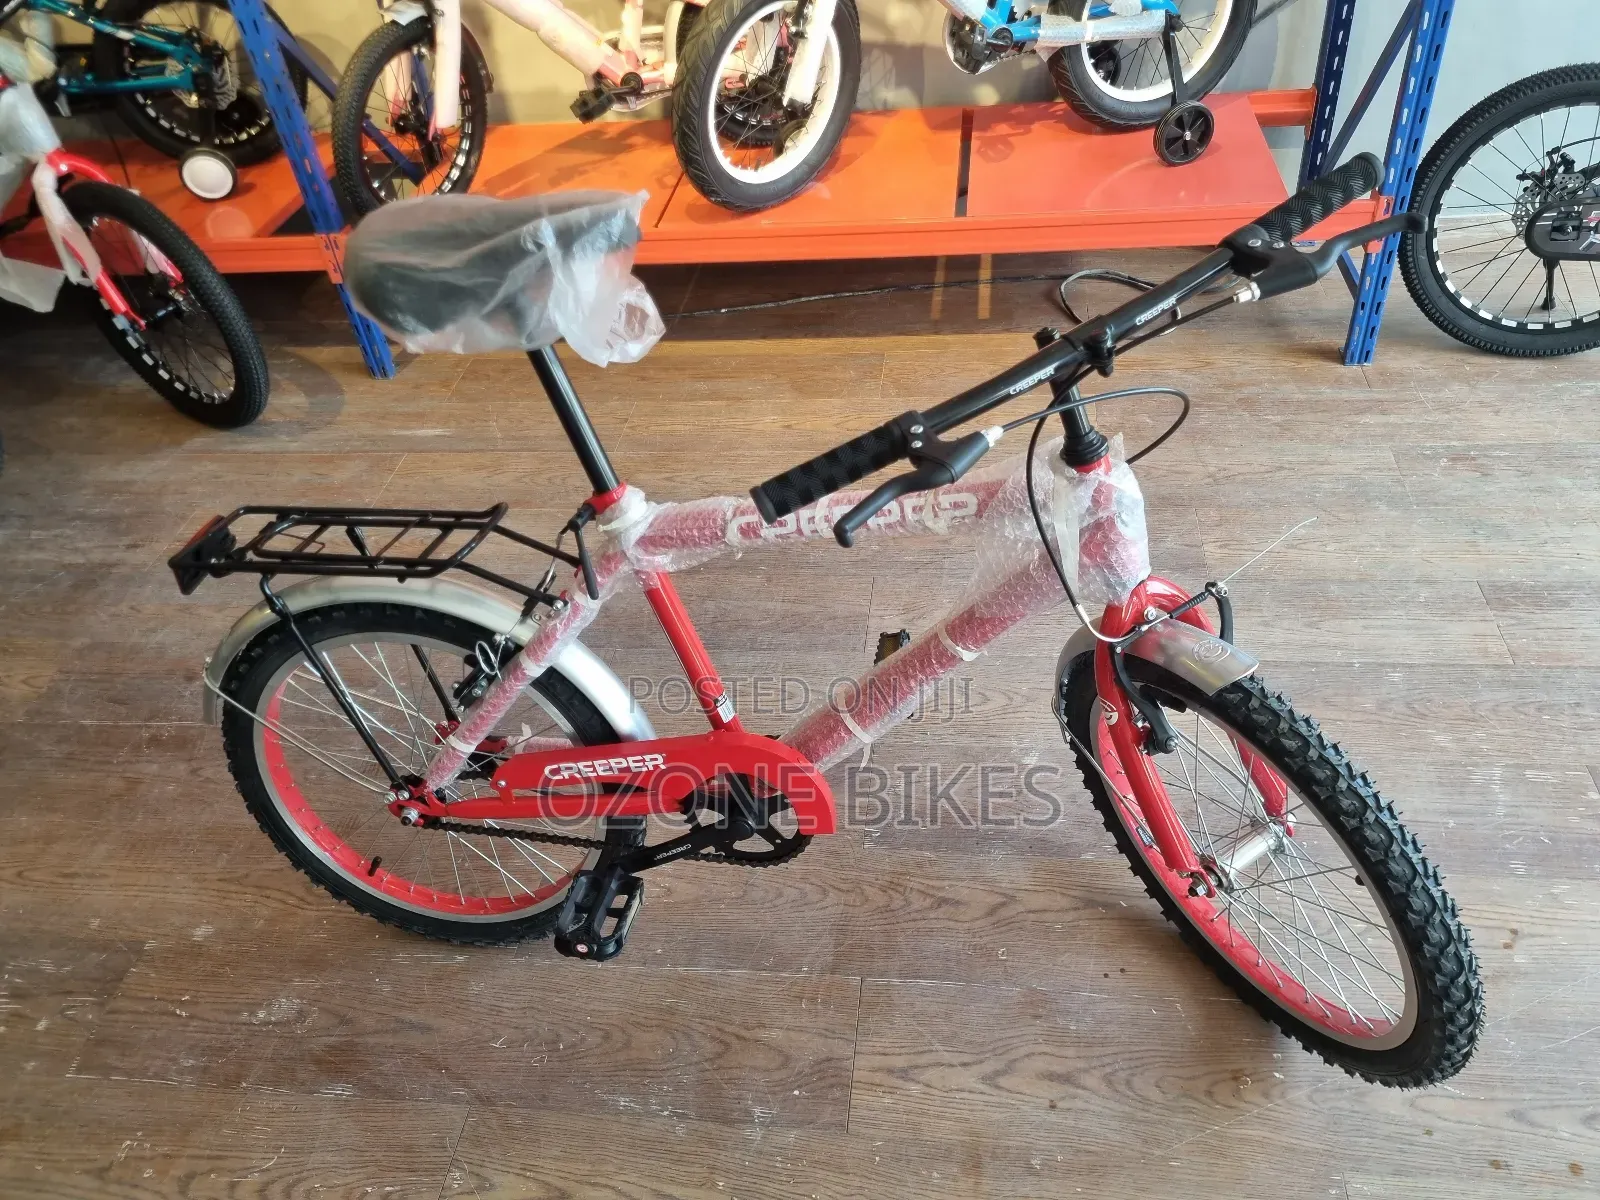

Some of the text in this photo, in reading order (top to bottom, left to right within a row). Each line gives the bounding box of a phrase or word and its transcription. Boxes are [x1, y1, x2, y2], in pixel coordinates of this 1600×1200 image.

[1135, 295, 1177, 325] CREEPER
[1009, 366, 1056, 395] CREEPER
[544, 753, 667, 780] CREEPER
